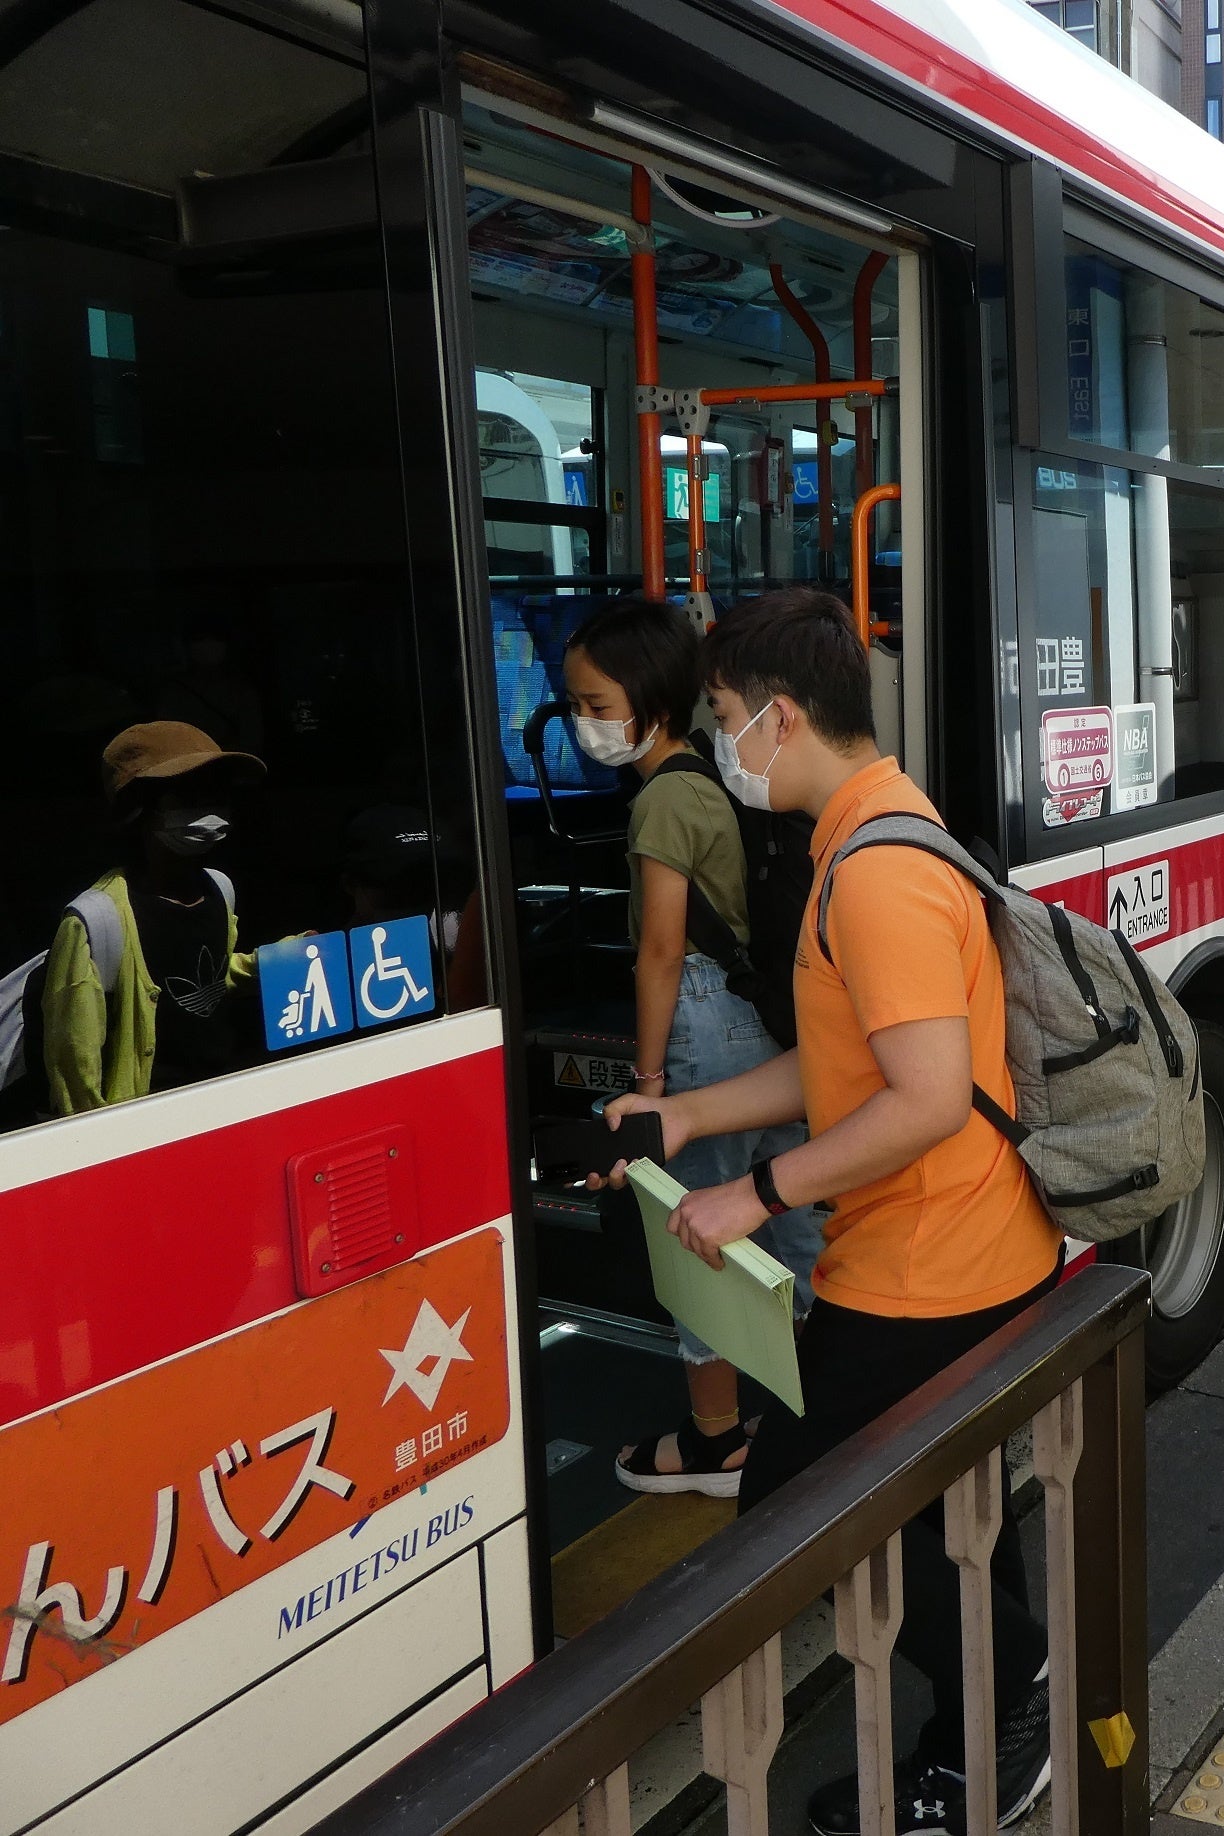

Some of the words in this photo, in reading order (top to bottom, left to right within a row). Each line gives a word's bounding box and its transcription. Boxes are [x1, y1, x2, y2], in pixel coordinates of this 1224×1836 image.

[1124, 728, 1148, 750] NBA
[1132, 868, 1163, 911] 入口
[1127, 906, 1168, 939] ENTRANCE
[395, 1410, 468, 1472] 豊田市
[277, 1532, 418, 1639] MEITETSU
[426, 1495, 475, 1549] BUS
